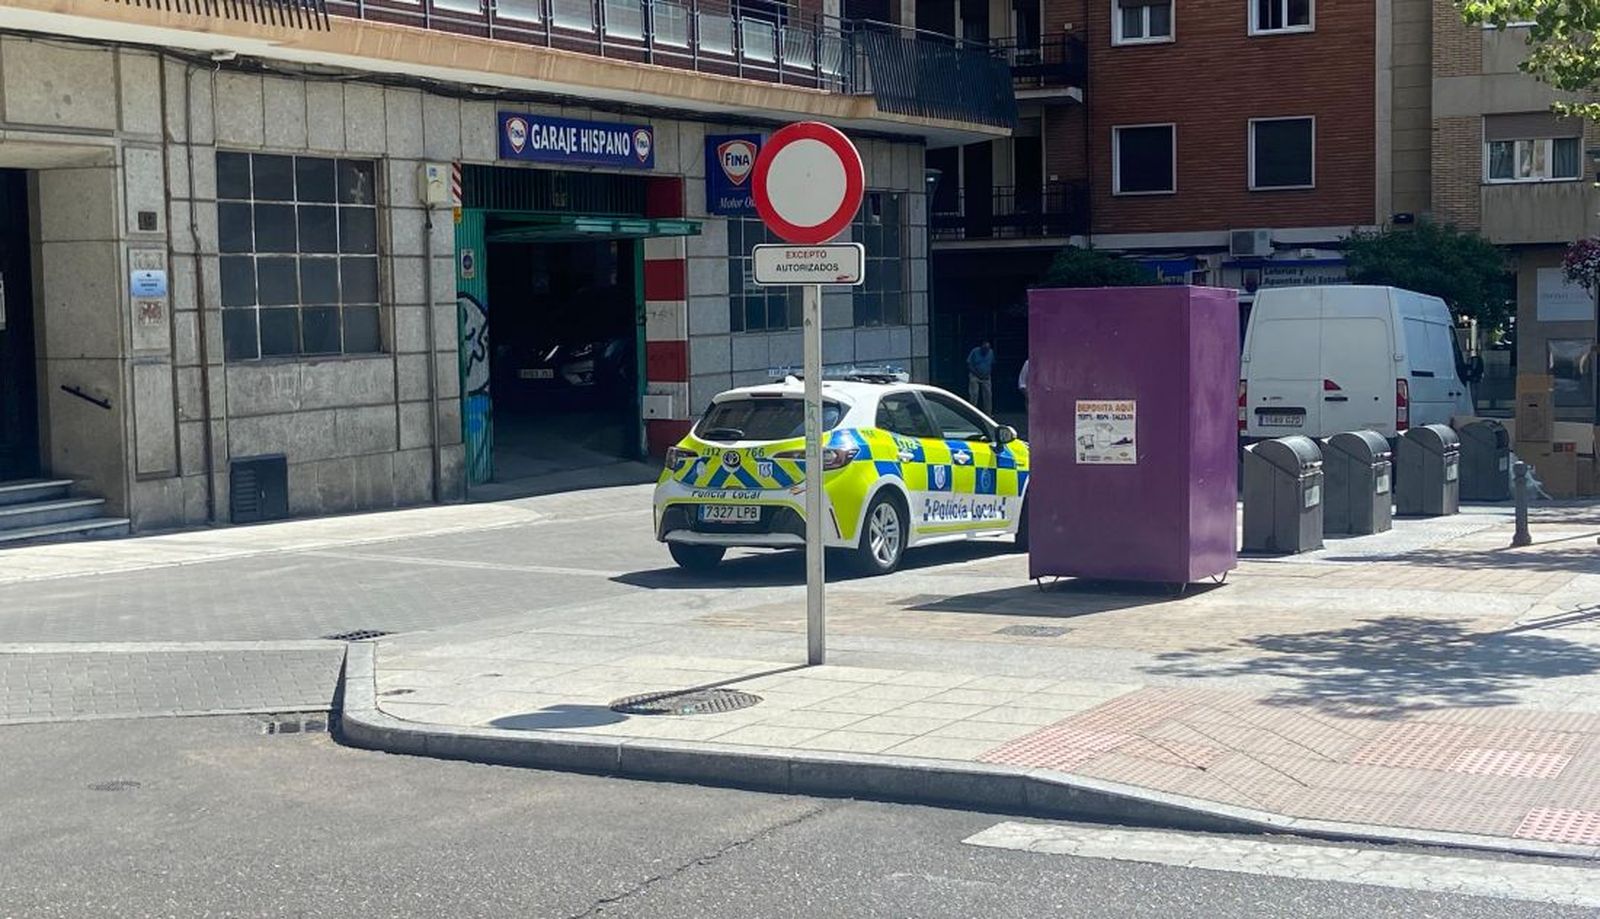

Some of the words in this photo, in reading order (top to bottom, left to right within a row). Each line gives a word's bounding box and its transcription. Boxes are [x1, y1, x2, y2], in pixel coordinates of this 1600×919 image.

[531, 123, 578, 154] GARAJE
[581, 128, 631, 156] HISPANO
[725, 152, 750, 167] FINA
[720, 197, 743, 209] Motor
[785, 250, 827, 259] EXCEPTO
[776, 263, 839, 272] AUTORIZADOS
[1264, 276, 1301, 285] Apuestas
[1303, 275, 1316, 284] del
[1077, 403, 1113, 412] DEPOSITA
[745, 447, 765, 458] 766
[732, 490, 761, 500] Local
[705, 506, 734, 519] 7327
[736, 507, 758, 519] LPB
[931, 498, 968, 520] Policía
[970, 499, 998, 519] Local
